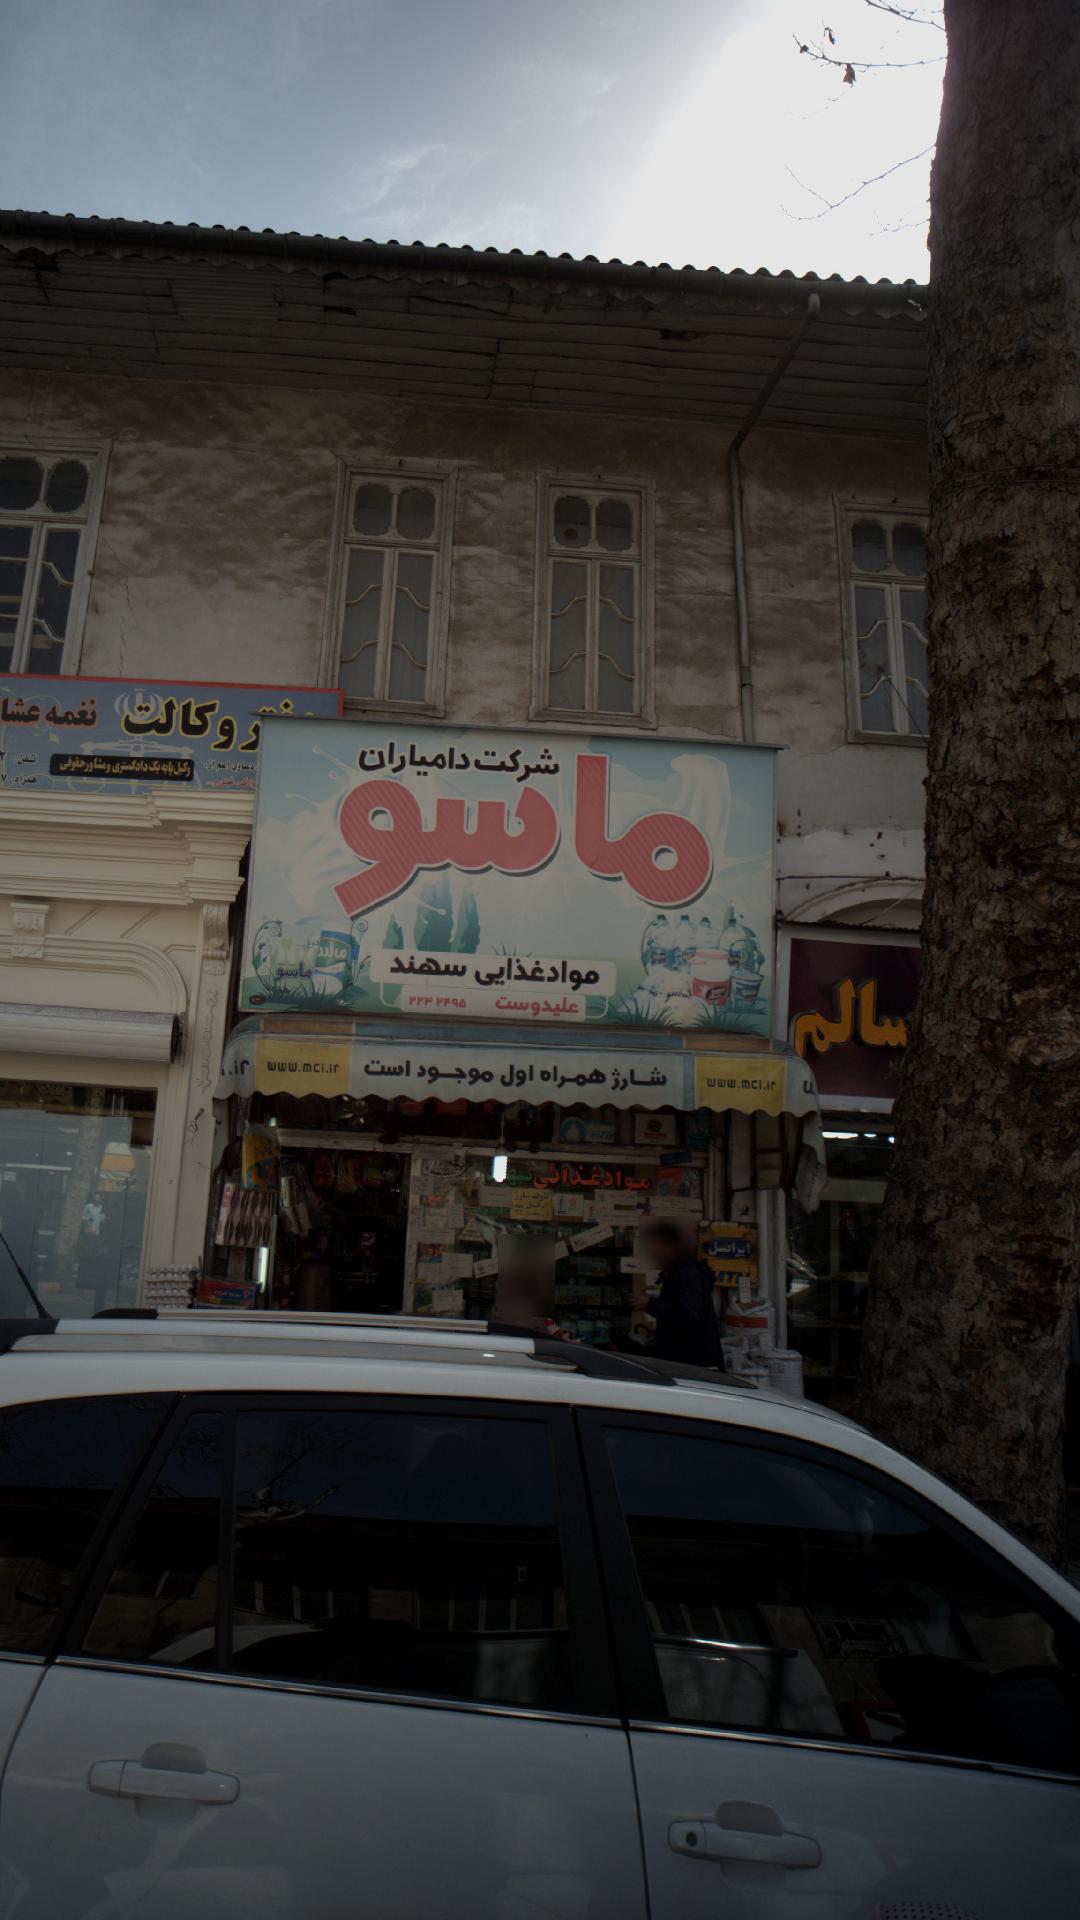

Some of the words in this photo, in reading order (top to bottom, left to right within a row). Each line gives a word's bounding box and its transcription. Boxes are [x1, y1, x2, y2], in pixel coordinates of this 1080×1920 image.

[45, 698, 97, 726] نغمه
[122, 698, 237, 751] وکالت
[358, 742, 470, 777] دامیاران
[473, 747, 560, 782] شرکت
[334, 754, 712, 919] ماسو
[390, 955, 467, 977] سهند
[495, 995, 580, 1016] علیدوست
[266, 1061, 340, 1074] www.mci.ir
[363, 1057, 411, 1080] است
[416, 1061, 495, 1087] موجود
[500, 1064, 535, 1088] اول
[539, 1065, 606, 1087] همراه
[611, 1065, 668, 1091] شارژ
[706, 1077, 777, 1091] www.mci.ir
